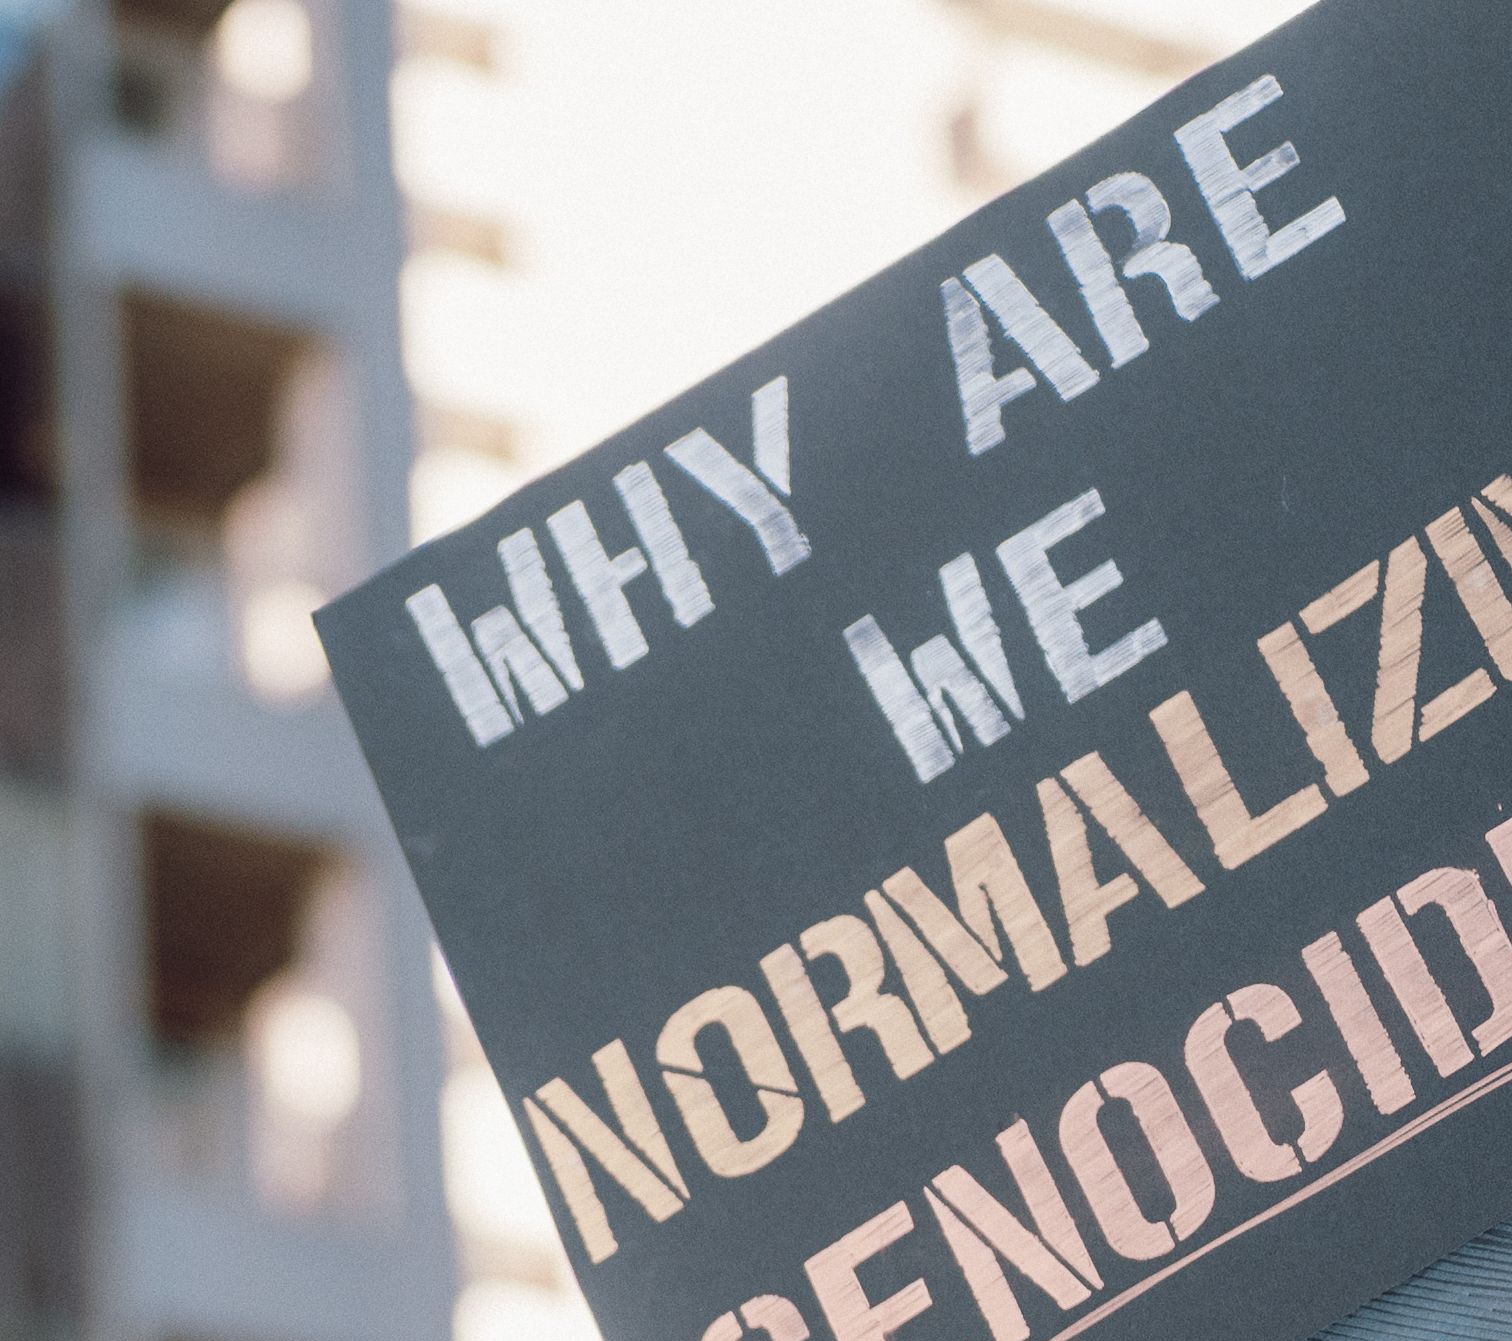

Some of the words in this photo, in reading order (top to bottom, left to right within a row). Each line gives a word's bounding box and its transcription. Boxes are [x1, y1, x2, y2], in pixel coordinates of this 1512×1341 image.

[407, 377, 811, 747] WHY
[940, 75, 1346, 455] ARE
[845, 488, 1168, 782] WE
